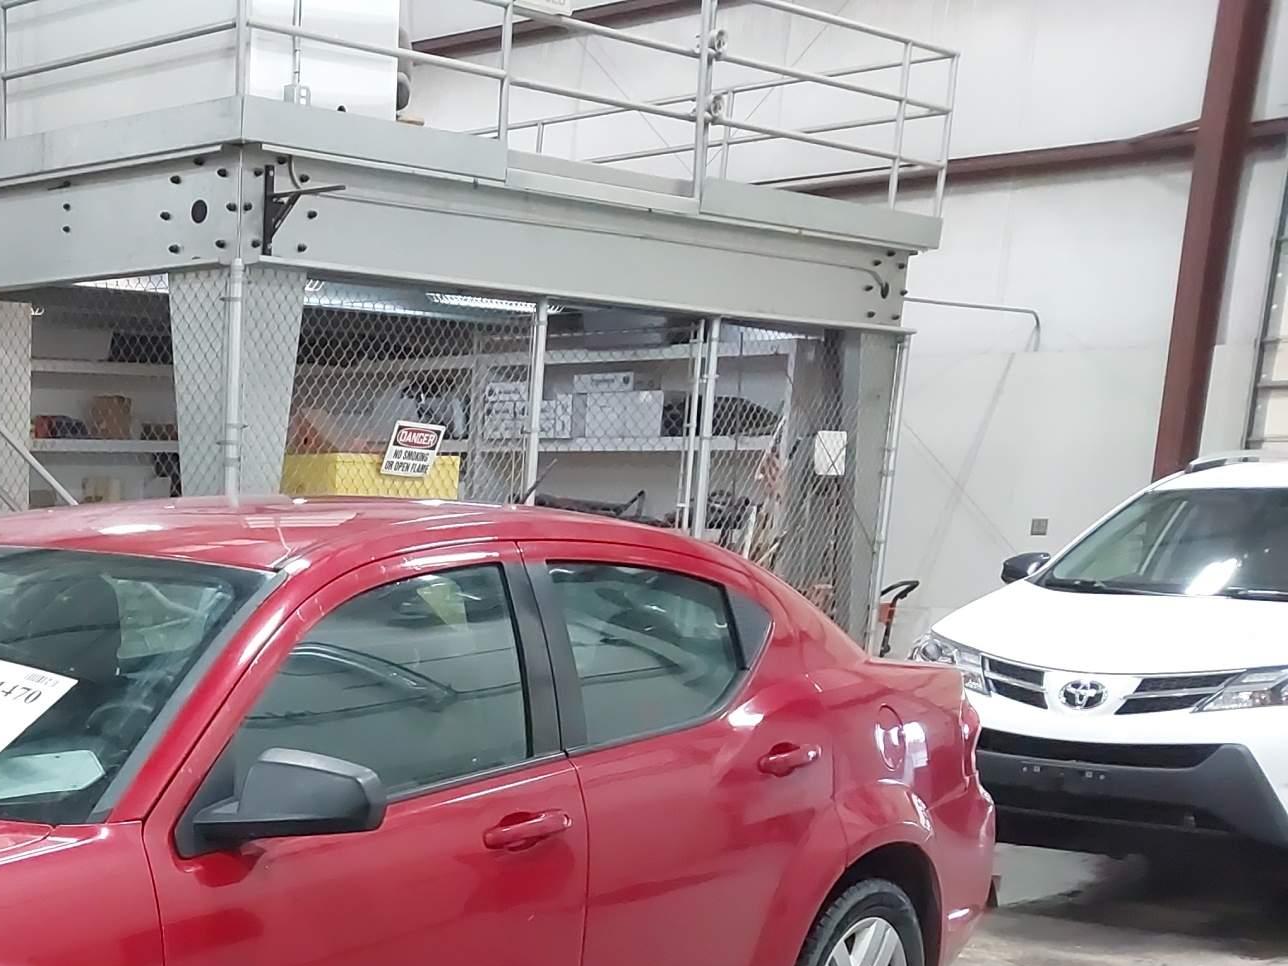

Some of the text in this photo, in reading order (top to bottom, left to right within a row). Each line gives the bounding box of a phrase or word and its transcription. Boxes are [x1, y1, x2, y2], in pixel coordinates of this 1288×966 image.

[399, 430, 436, 447] DANGER
[393, 449, 430, 462] NO SMOKING
[384, 460, 430, 474] OR OPEN FLAME
